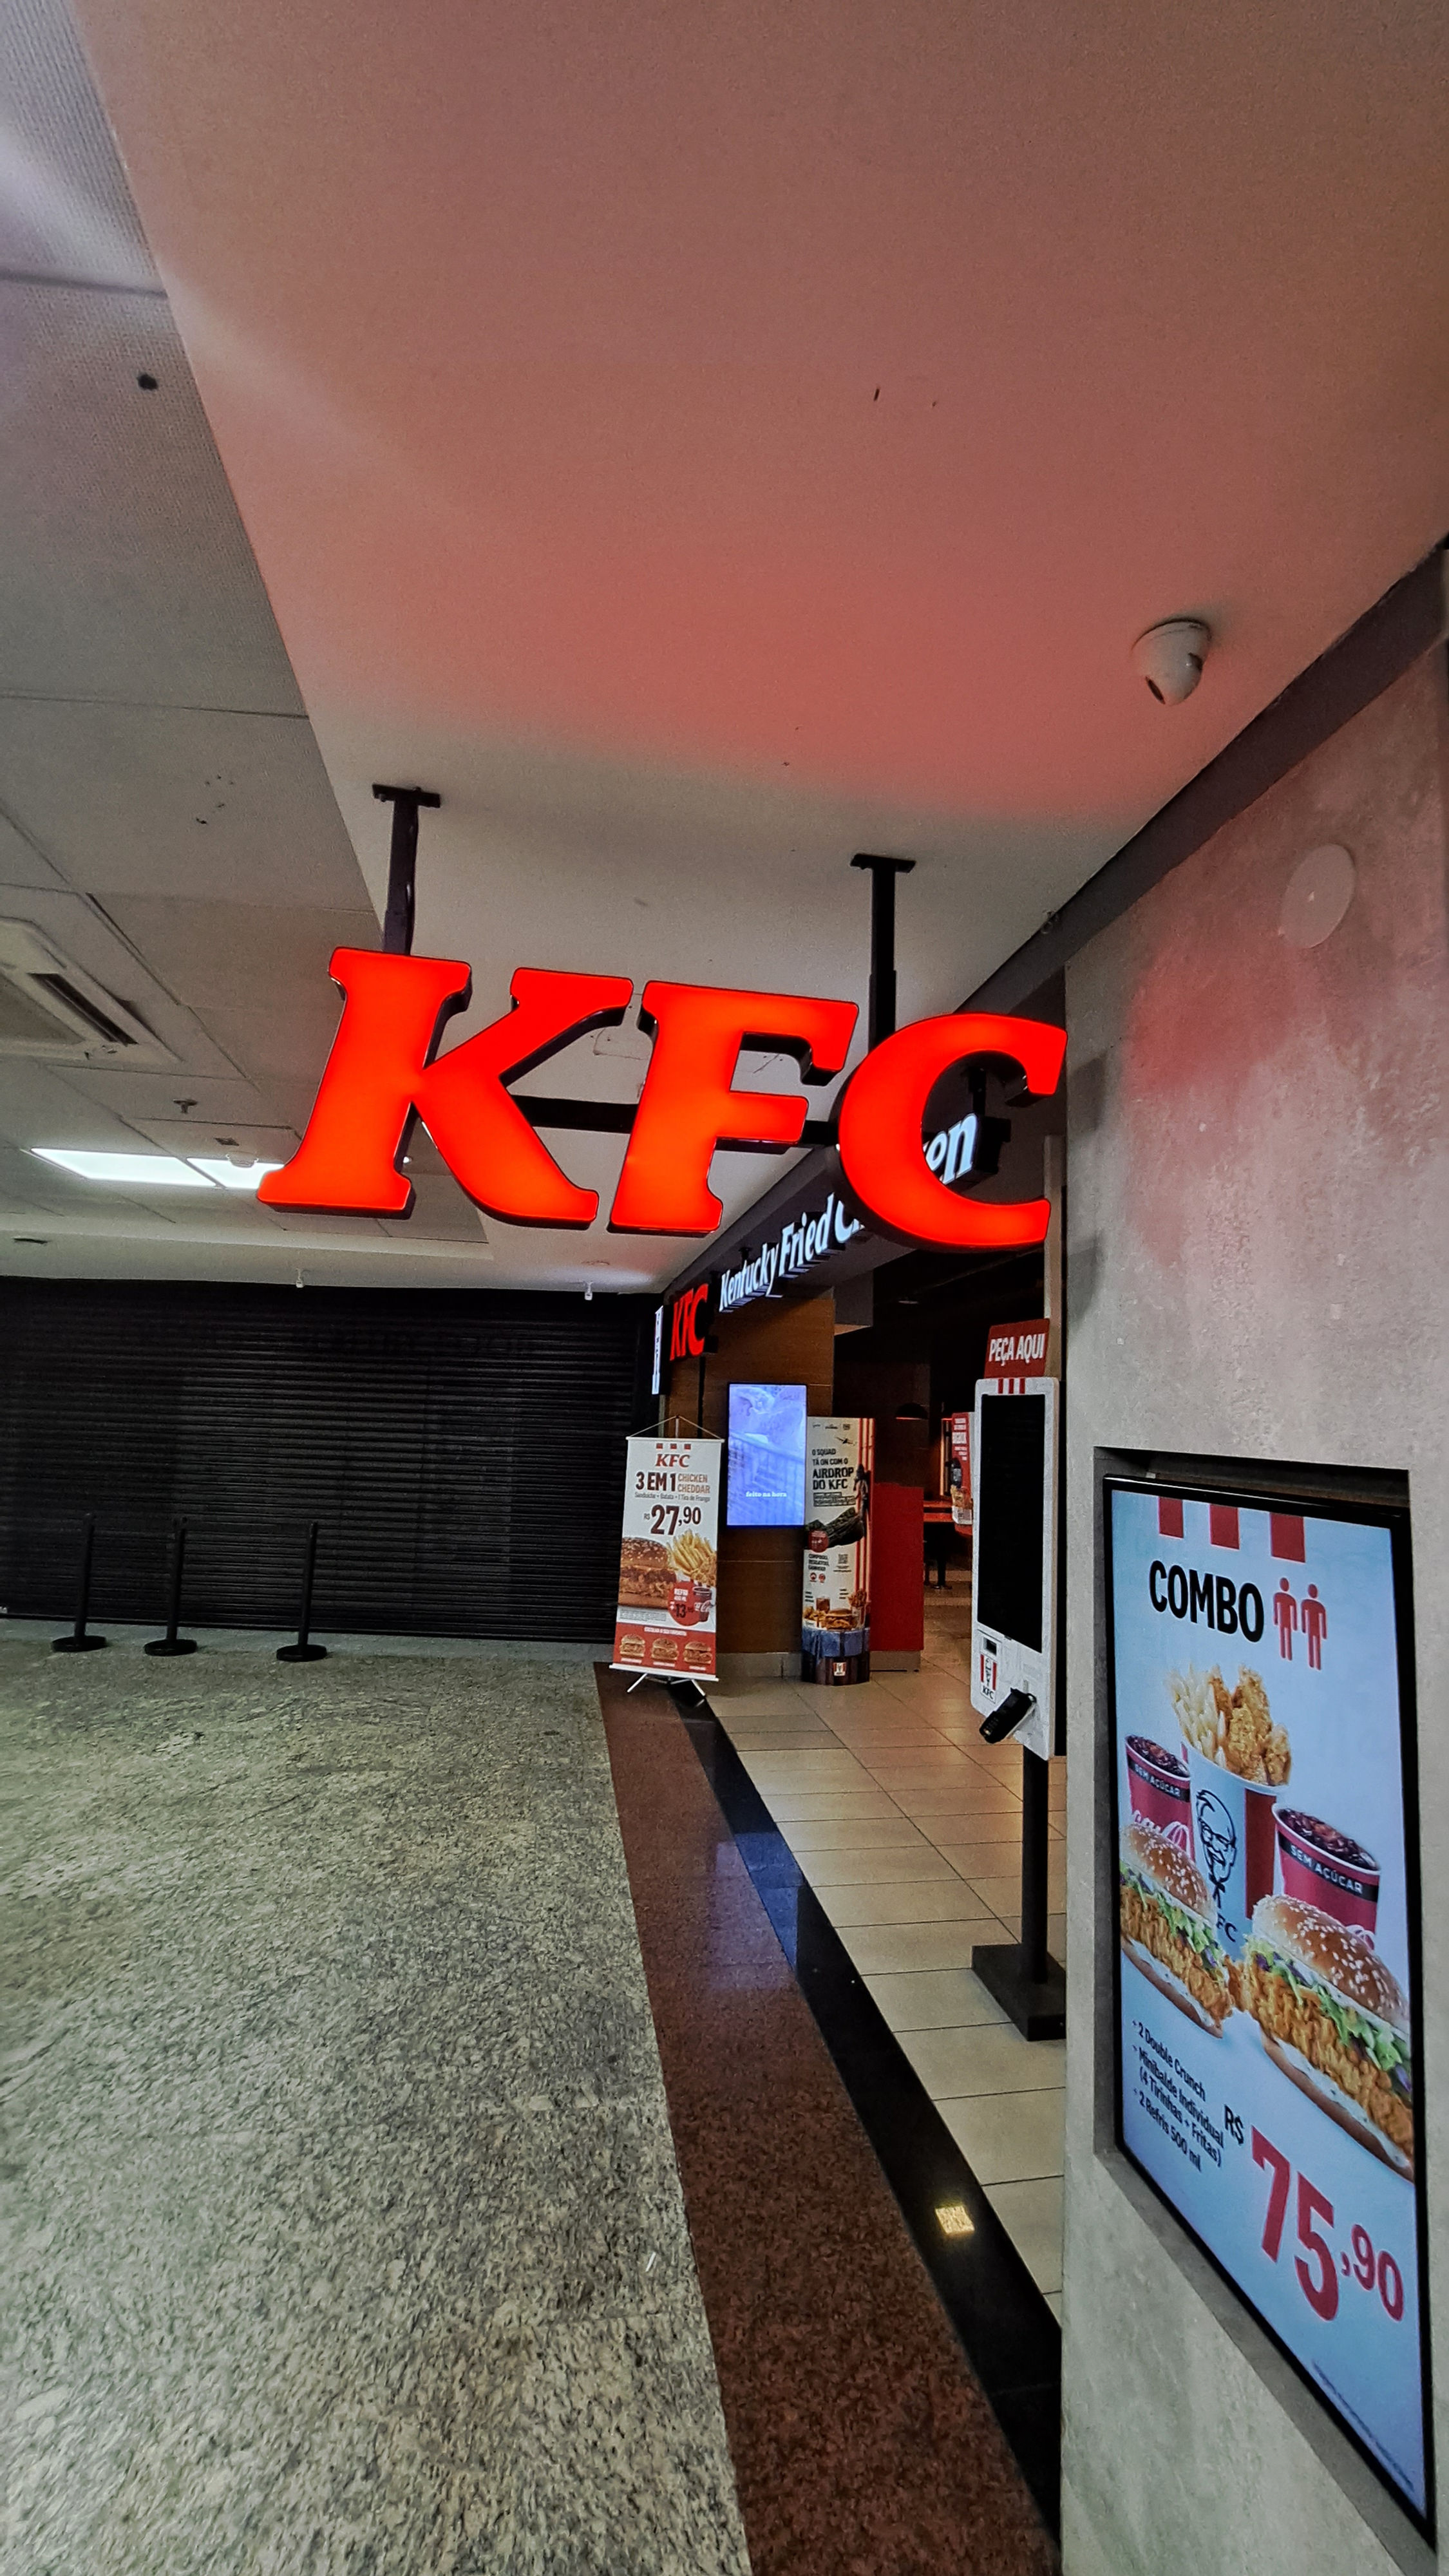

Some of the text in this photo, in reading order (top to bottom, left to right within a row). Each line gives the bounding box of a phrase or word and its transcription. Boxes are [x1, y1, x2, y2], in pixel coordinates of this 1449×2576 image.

[258, 947, 1068, 1249] KFC
[719, 1192, 835, 1312] Kentucky Fried
[670, 1283, 708, 1361] KFC
[989, 1333, 1045, 1367] PEÇA AQUI
[655, 1454, 690, 1468] KFC
[677, 1473, 708, 1483] CHICKEN
[813, 1466, 855, 1479] AIRDROP
[636, 1472, 676, 1492] 3 EM 1
[677, 1483, 711, 1493] CHEDDAR
[813, 1479, 848, 1490] DO KFC
[650, 1504, 701, 1535] 27,90
[1150, 1560, 1264, 1643] COMBO
[982, 1685, 994, 1700] KFC
[1135, 1764, 1180, 1797] SEM AÇÚCAR
[1290, 1844, 1364, 1895] SEM AÇÚCAR
[1217, 1912, 1238, 1943] FC
[1139, 2022, 1206, 2102] 2 Double Crunch
[1139, 2047, 1224, 2149] Minibalde Individual
[1139, 2092, 1146, 2108] 2
[1146, 2097, 1170, 2136] Refris
[1171, 2125, 1188, 2155] 500
[1150, 2075, 1183, 2125] Tirinhas
[1191, 2123, 1222, 2168] Fritas)
[1224, 2103, 1245, 2146] R$
[1251, 2125, 1405, 2322] 75,90
